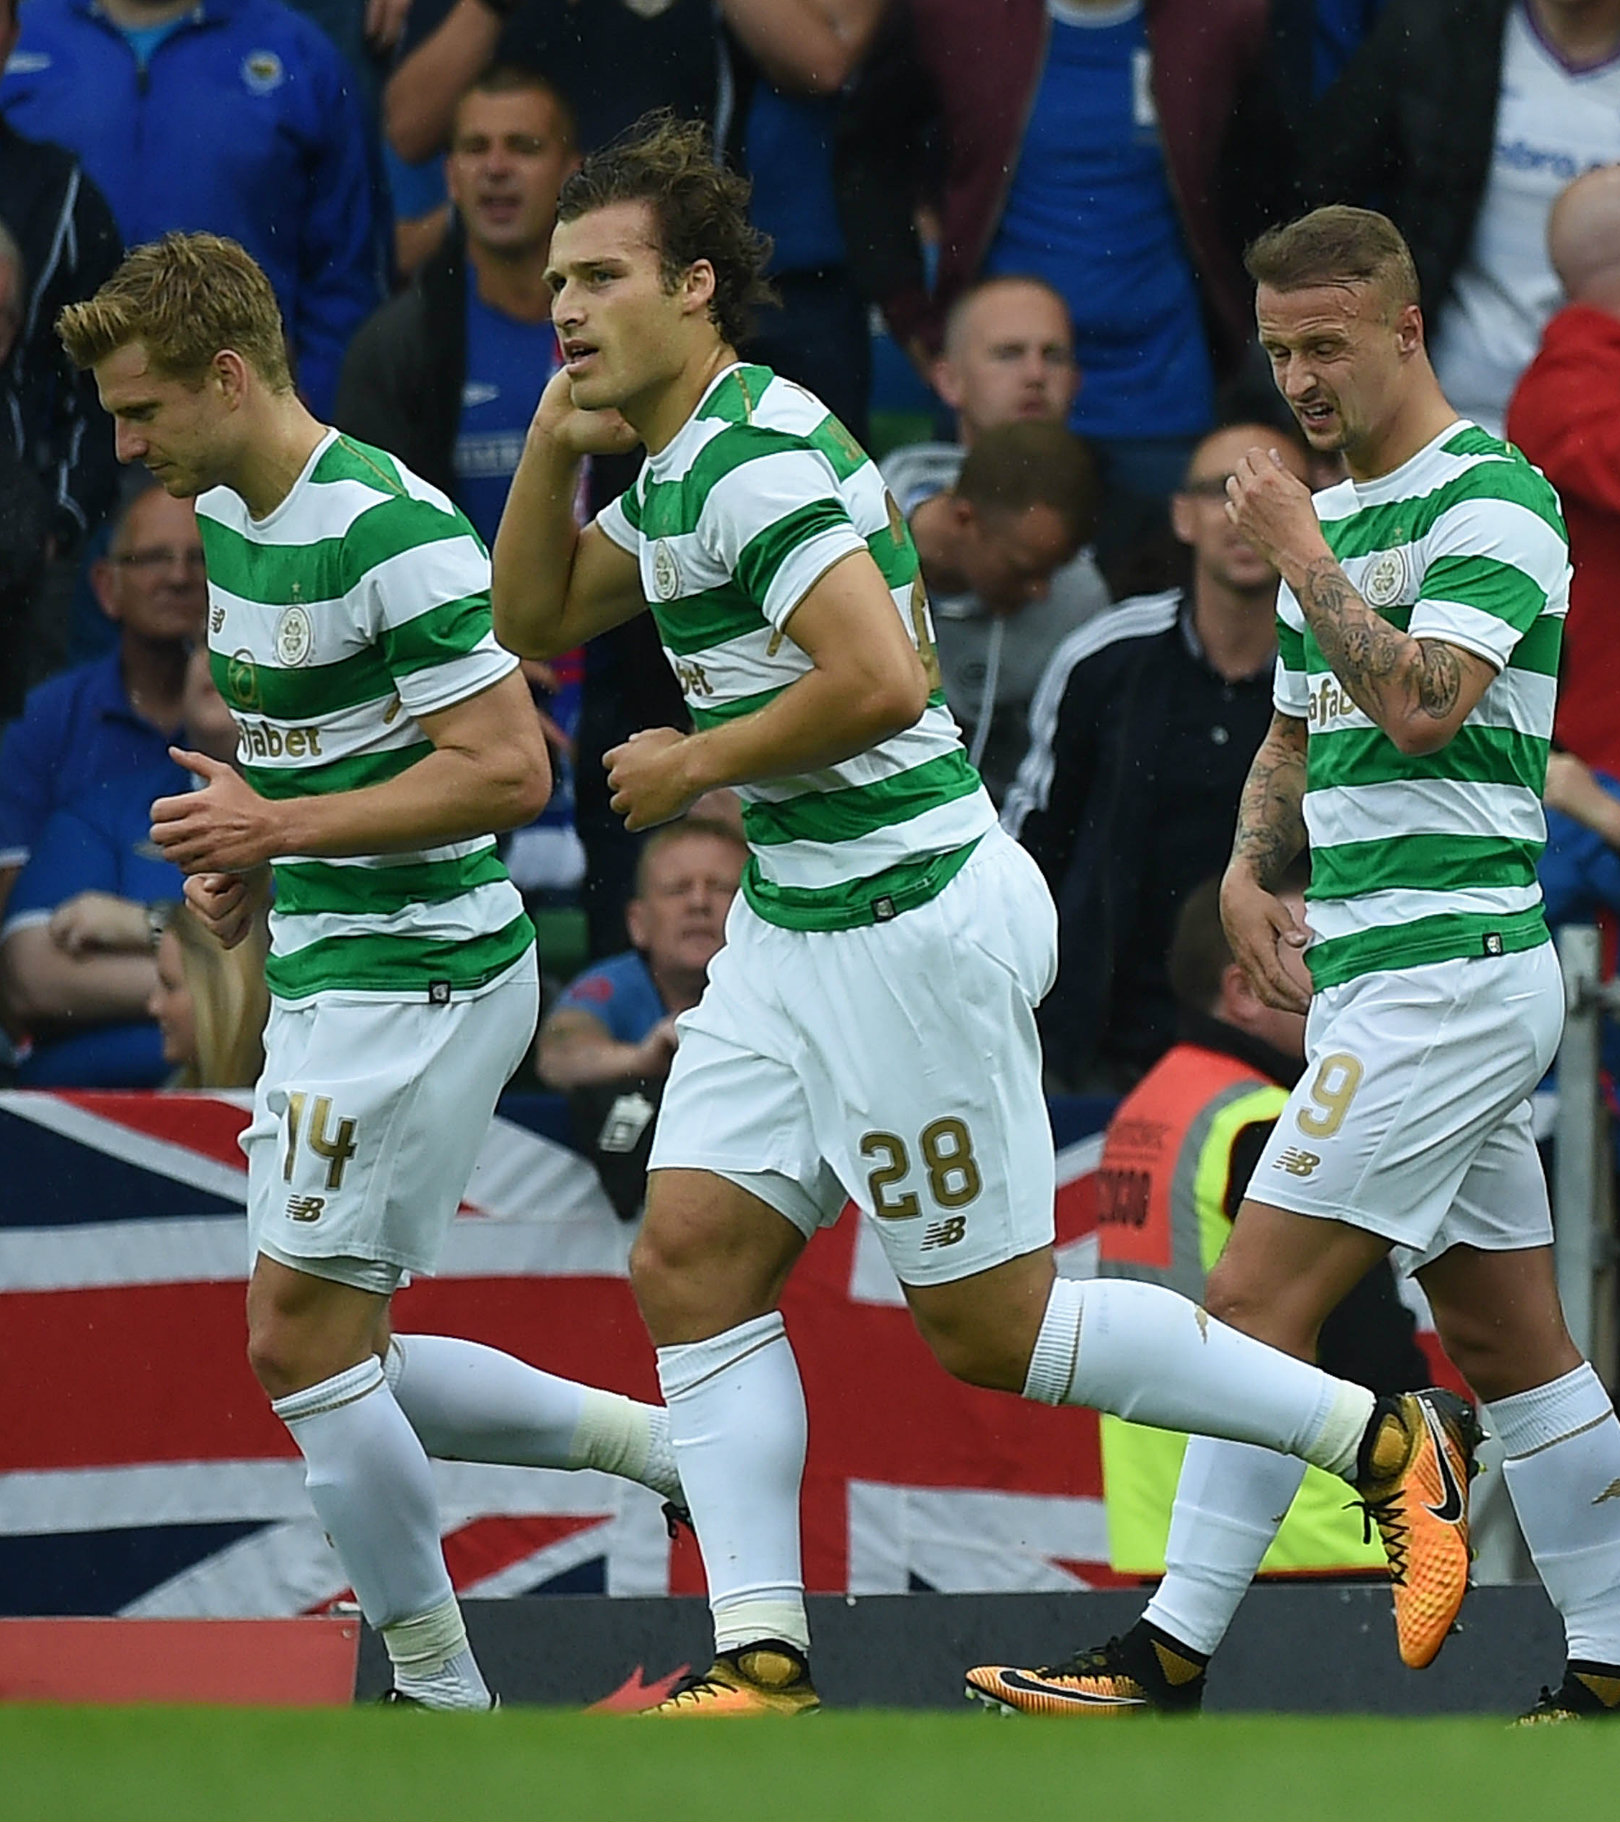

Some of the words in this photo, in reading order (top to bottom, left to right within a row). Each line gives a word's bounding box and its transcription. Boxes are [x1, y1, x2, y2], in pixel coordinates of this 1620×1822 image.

[283, 1090, 359, 1192] 14
[1294, 1051, 1365, 1140] 9
[859, 1115, 985, 1222] 28
